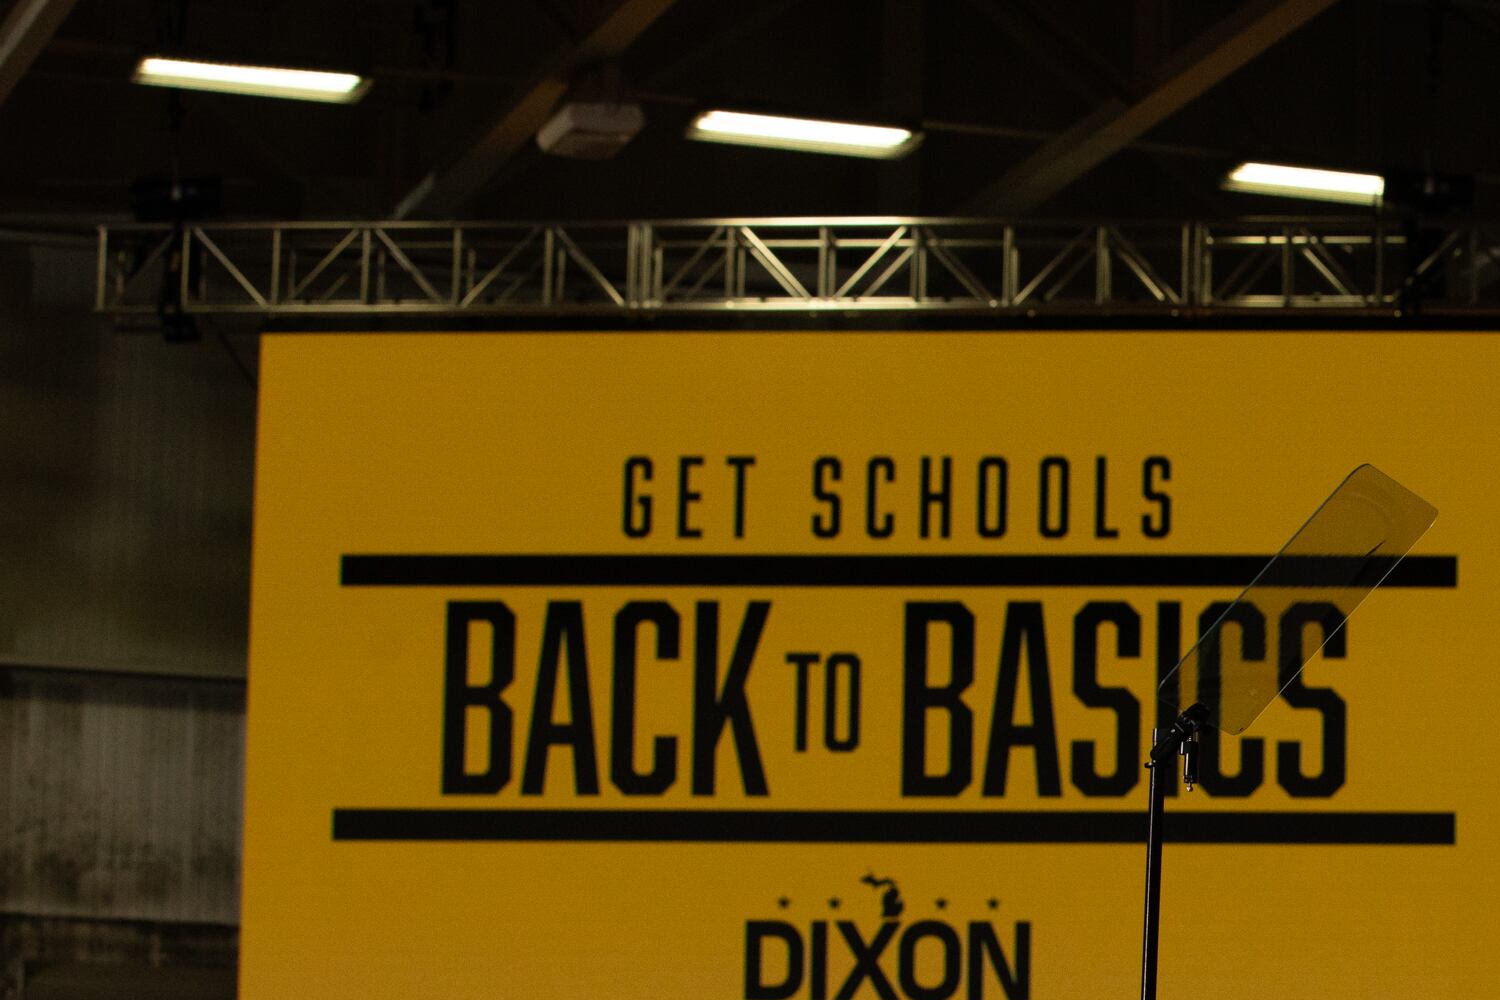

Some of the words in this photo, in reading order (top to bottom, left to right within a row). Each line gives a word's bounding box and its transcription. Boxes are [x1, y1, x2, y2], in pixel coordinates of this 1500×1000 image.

[622, 456, 756, 539] GET
[812, 456, 1173, 539] SCHOOLS
[441, 601, 769, 798] BACK
[787, 652, 861, 751] TO
[900, 601, 1348, 799] BASICS
